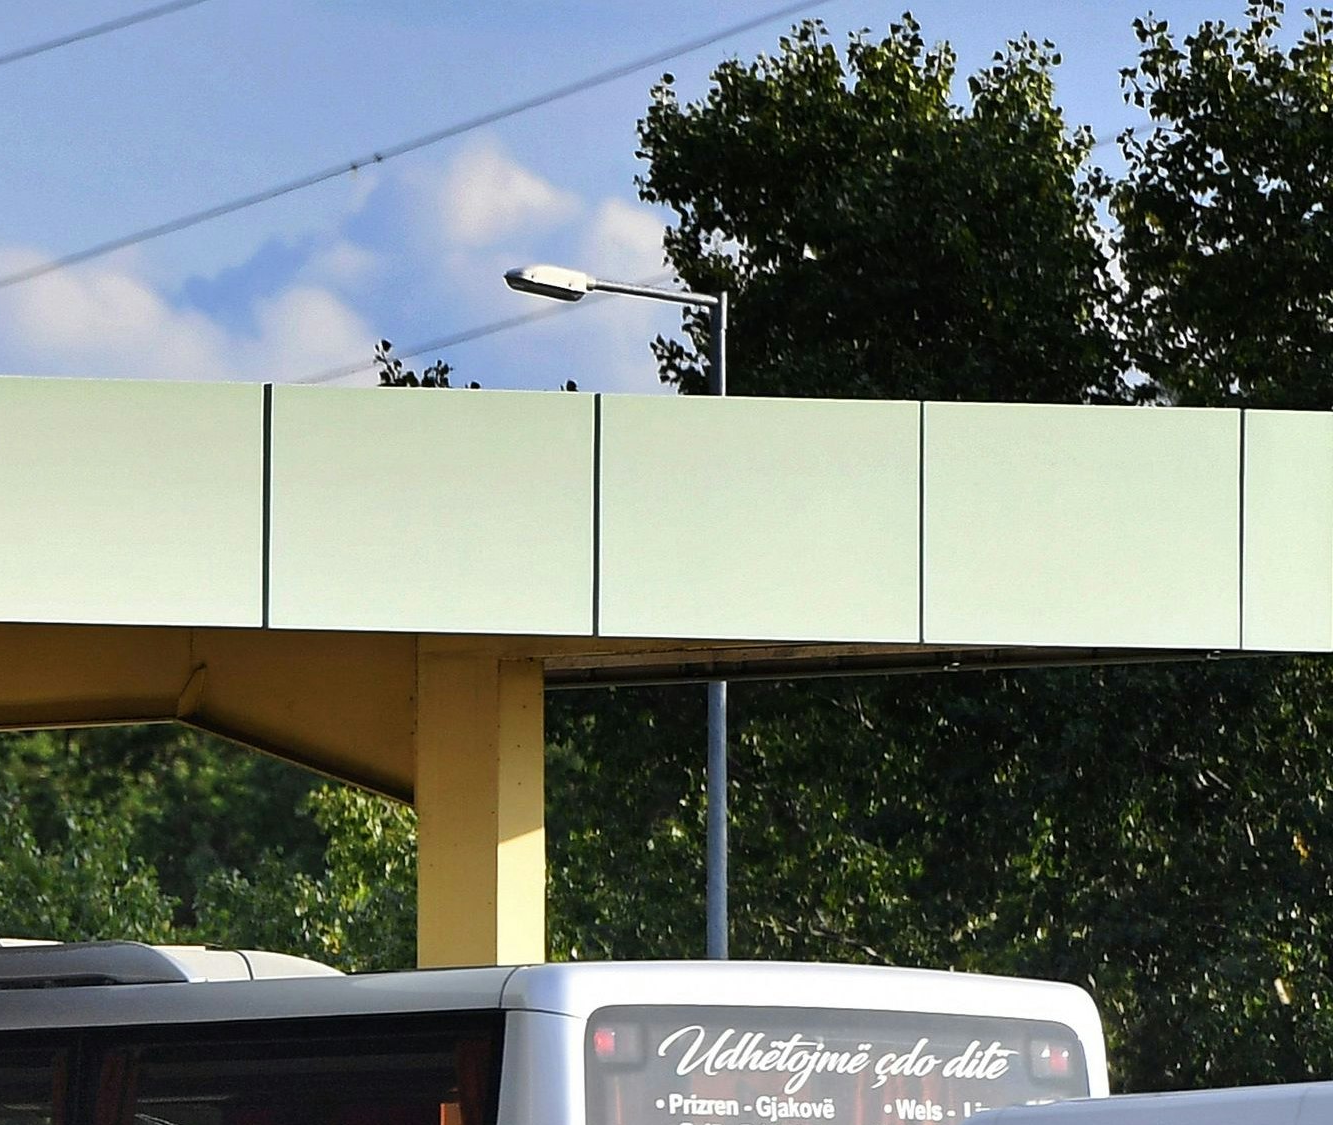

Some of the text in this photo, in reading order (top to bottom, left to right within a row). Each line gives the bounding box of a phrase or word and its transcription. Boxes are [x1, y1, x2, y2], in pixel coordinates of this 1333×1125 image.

[871, 1038, 943, 1089] çdo
[942, 1040, 1020, 1080] ditë
[669, 1093, 739, 1115] Prizren
[755, 1096, 835, 1122] Gjakovë
[895, 1099, 944, 1121] Wels
